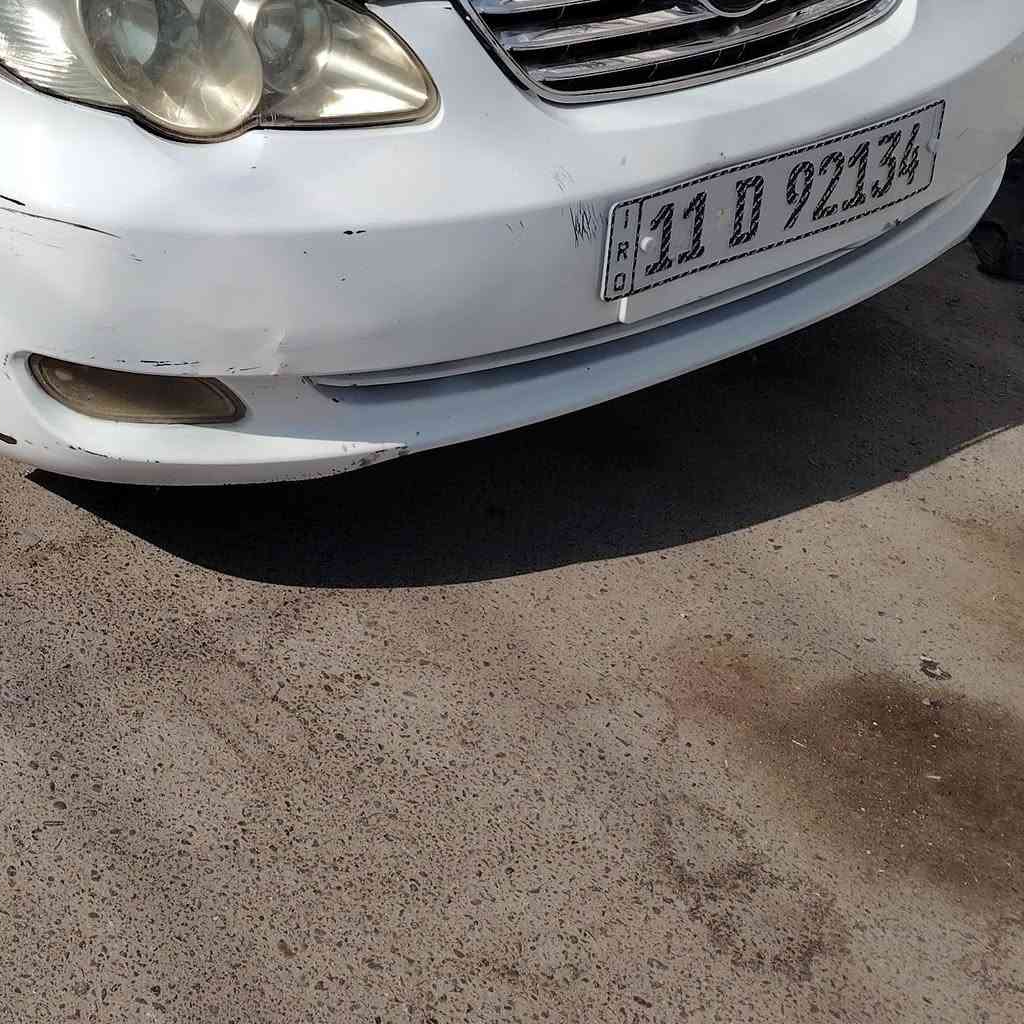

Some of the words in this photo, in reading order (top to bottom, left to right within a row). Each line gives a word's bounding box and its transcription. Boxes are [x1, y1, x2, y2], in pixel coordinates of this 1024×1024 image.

[645, 191, 707, 276] 11
[728, 175, 765, 249] D
[783, 122, 921, 231] 92134
